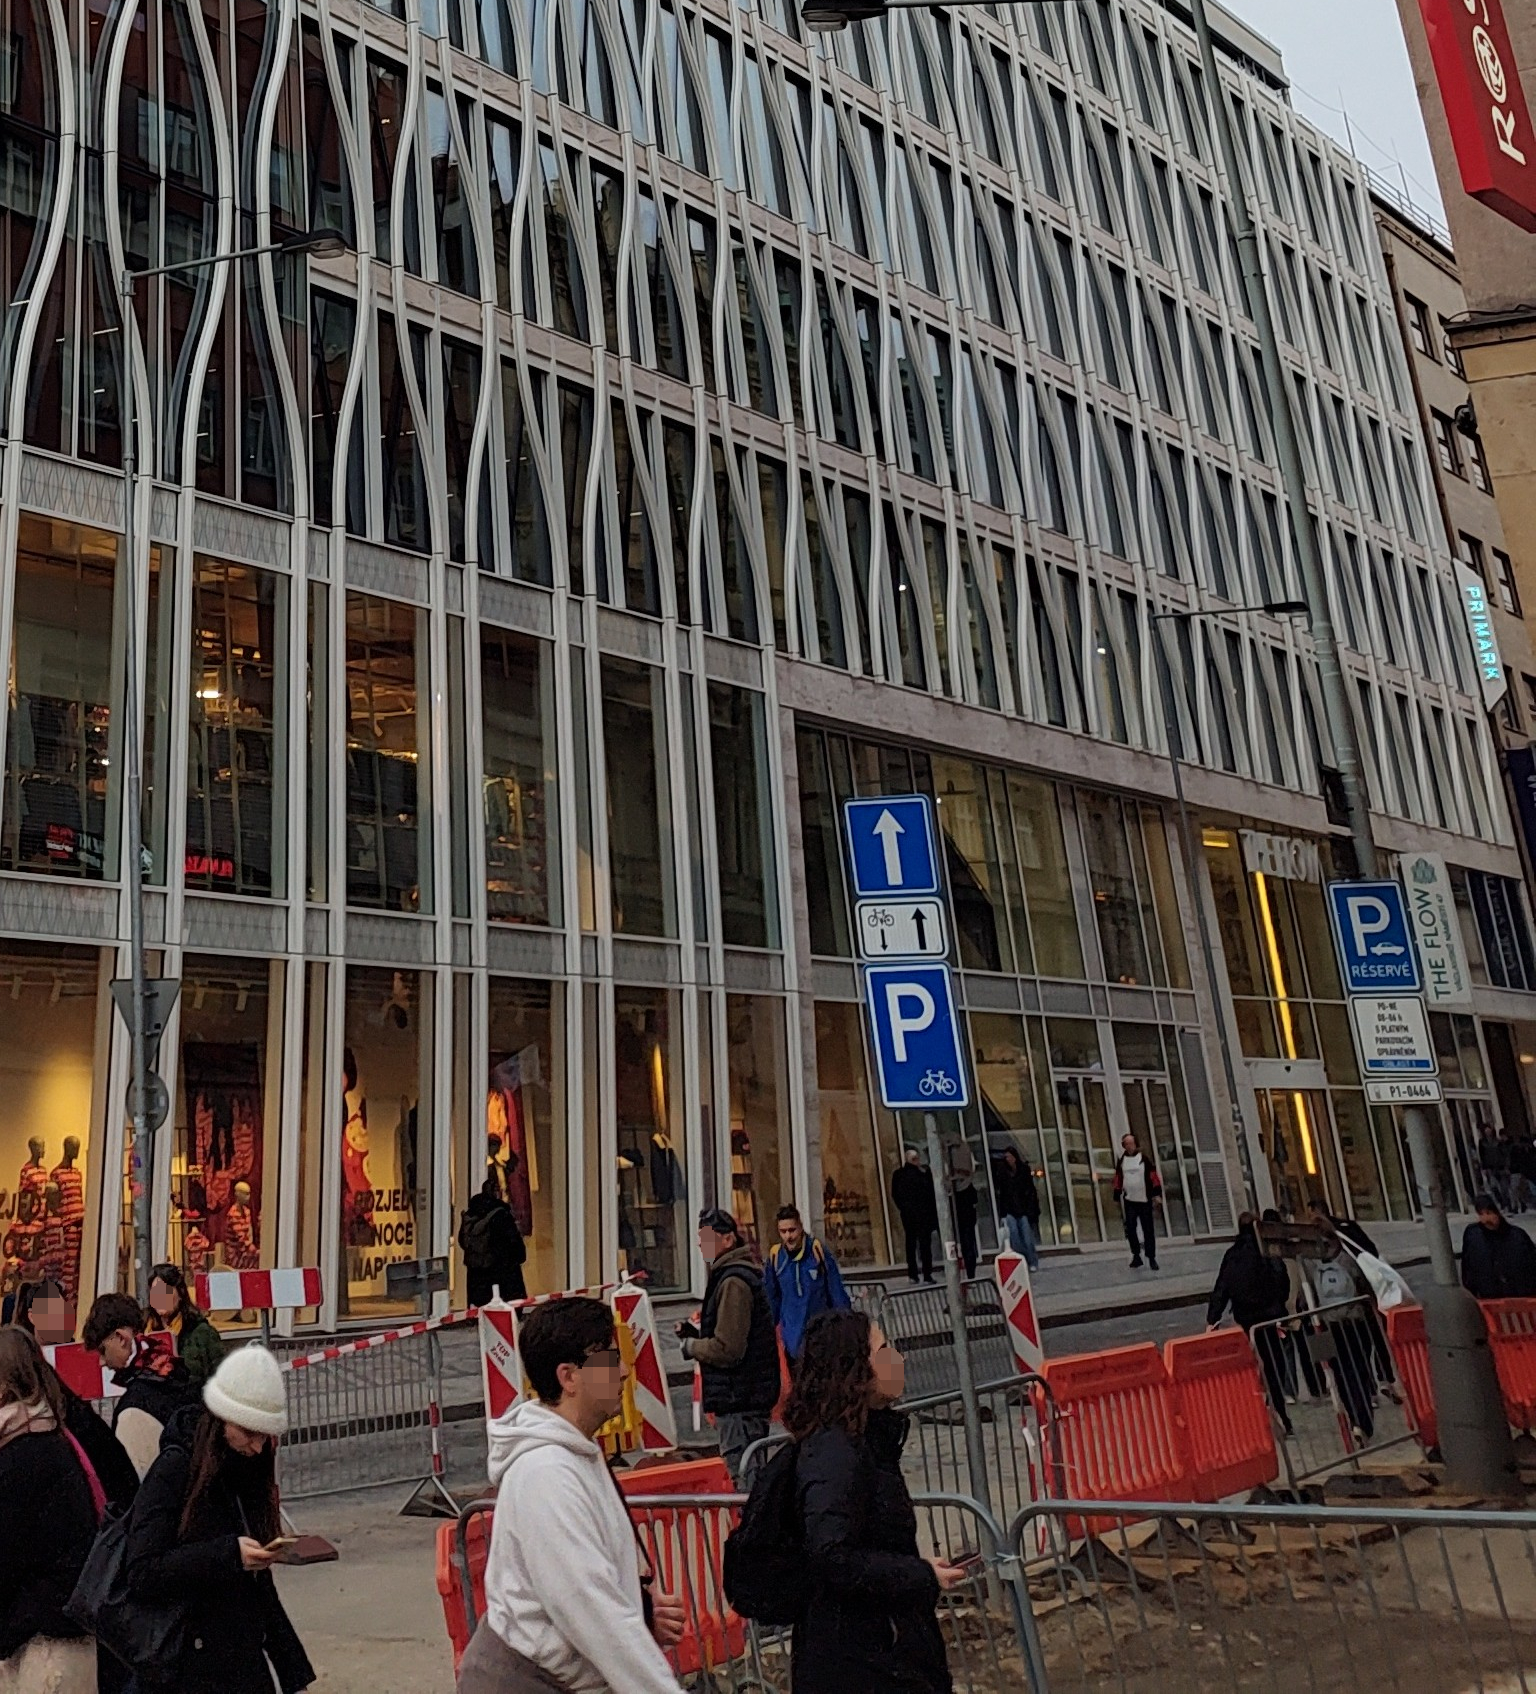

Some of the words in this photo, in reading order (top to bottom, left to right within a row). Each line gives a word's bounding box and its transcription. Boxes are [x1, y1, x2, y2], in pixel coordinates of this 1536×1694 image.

[1466, 586, 1501, 681] PRIMARK
[1346, 896, 1391, 957] P
[1413, 888, 1442, 949] FLOW
[1351, 961, 1412, 979] RÉSERVÉ
[1428, 957, 1452, 1000] THE
[885, 982, 936, 1063] P
[1390, 1085, 1432, 1098] P1-0464
